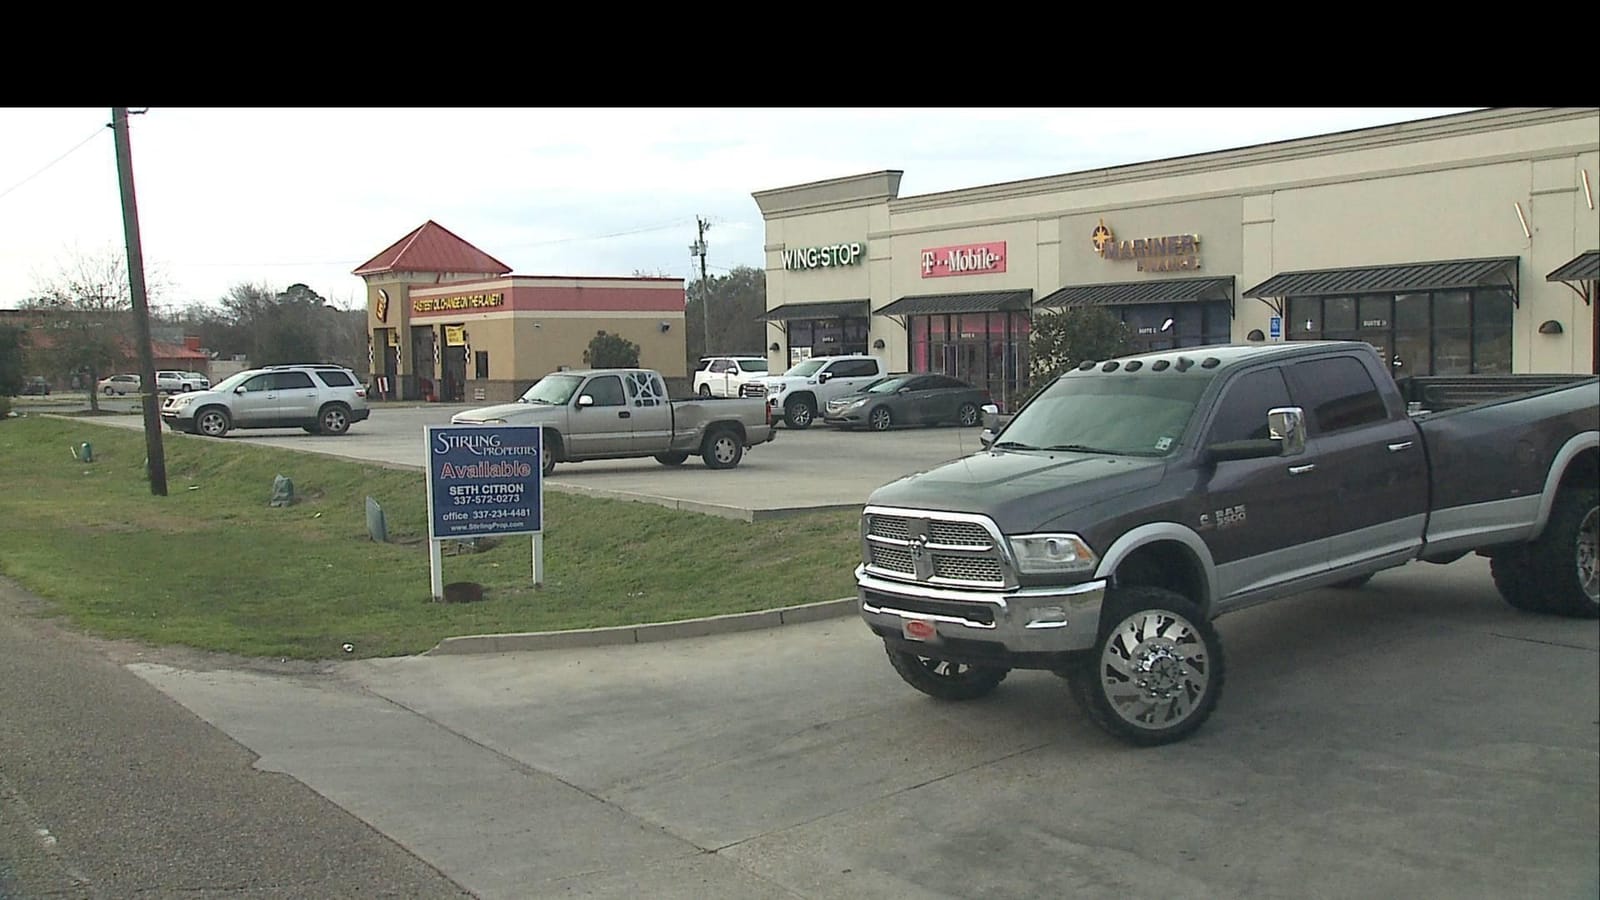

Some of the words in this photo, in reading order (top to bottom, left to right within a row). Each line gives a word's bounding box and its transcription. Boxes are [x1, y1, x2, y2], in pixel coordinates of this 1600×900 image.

[434, 432, 501, 455] STIRLING
[483, 446, 537, 456] PROPERTIES
[440, 460, 531, 480] Available
[449, 485, 479, 496] SETH
[481, 483, 524, 495] CITRON
[454, 494, 520, 505] 337-572-0273
[442, 511, 469, 521] office
[472, 508, 531, 519] 337-234-4481
